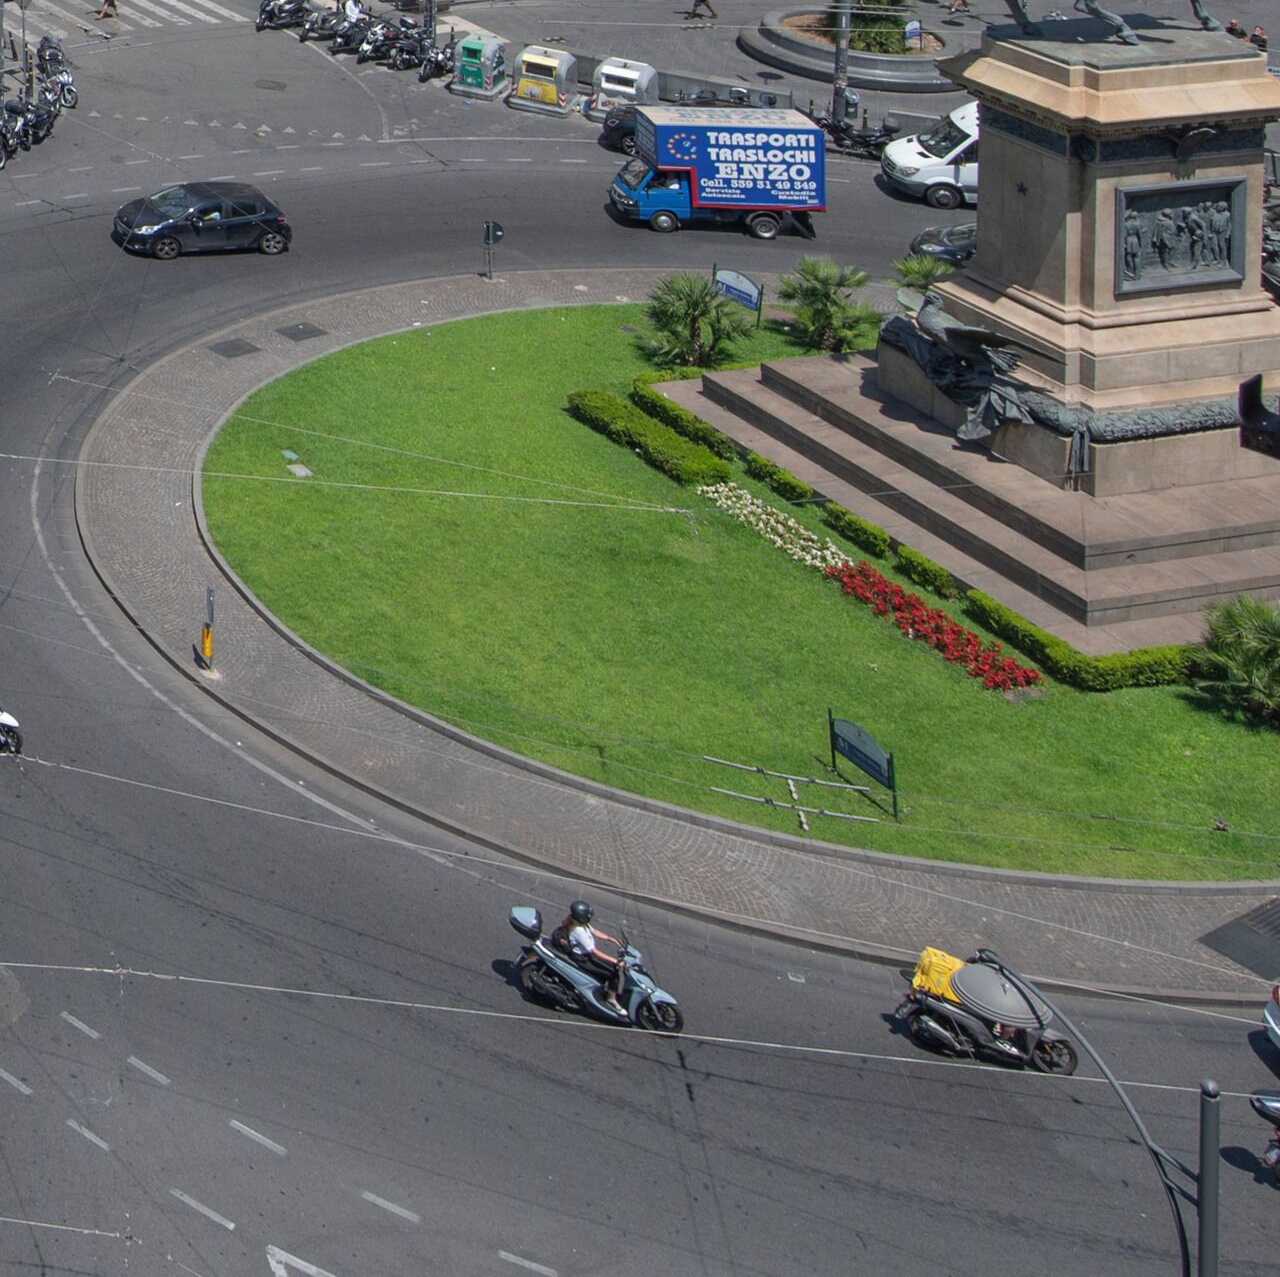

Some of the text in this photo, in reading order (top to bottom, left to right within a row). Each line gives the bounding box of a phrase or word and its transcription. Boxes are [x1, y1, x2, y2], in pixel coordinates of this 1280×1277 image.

[706, 131, 815, 147] TRASPORTI
[707, 148, 816, 163] TRASLOCHI
[714, 162, 811, 180] ENZO
[700, 178, 728, 187] Cell.
[775, 181, 791, 190] 49
